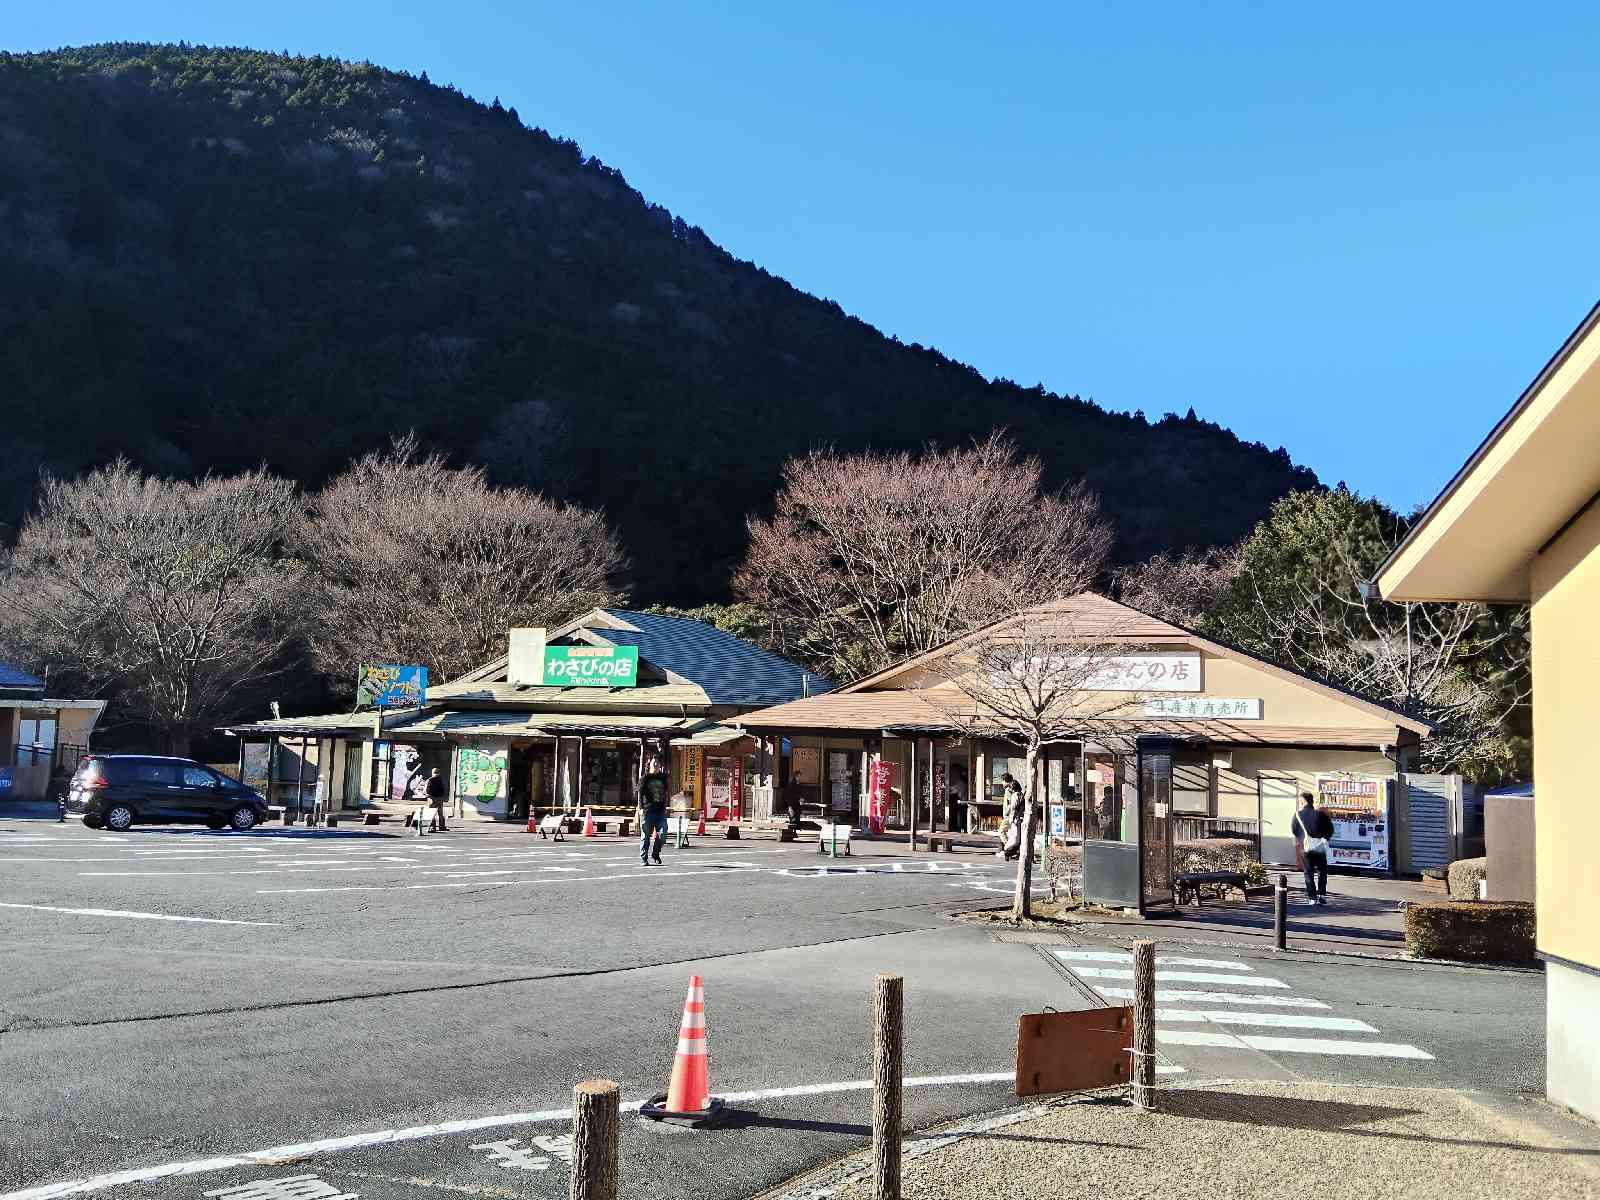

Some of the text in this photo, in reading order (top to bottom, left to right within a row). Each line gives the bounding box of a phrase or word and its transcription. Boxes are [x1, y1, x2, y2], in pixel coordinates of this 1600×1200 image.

[547, 658, 632, 677] わさびの店
[1150, 699, 1249, 716] 生産者直売所
